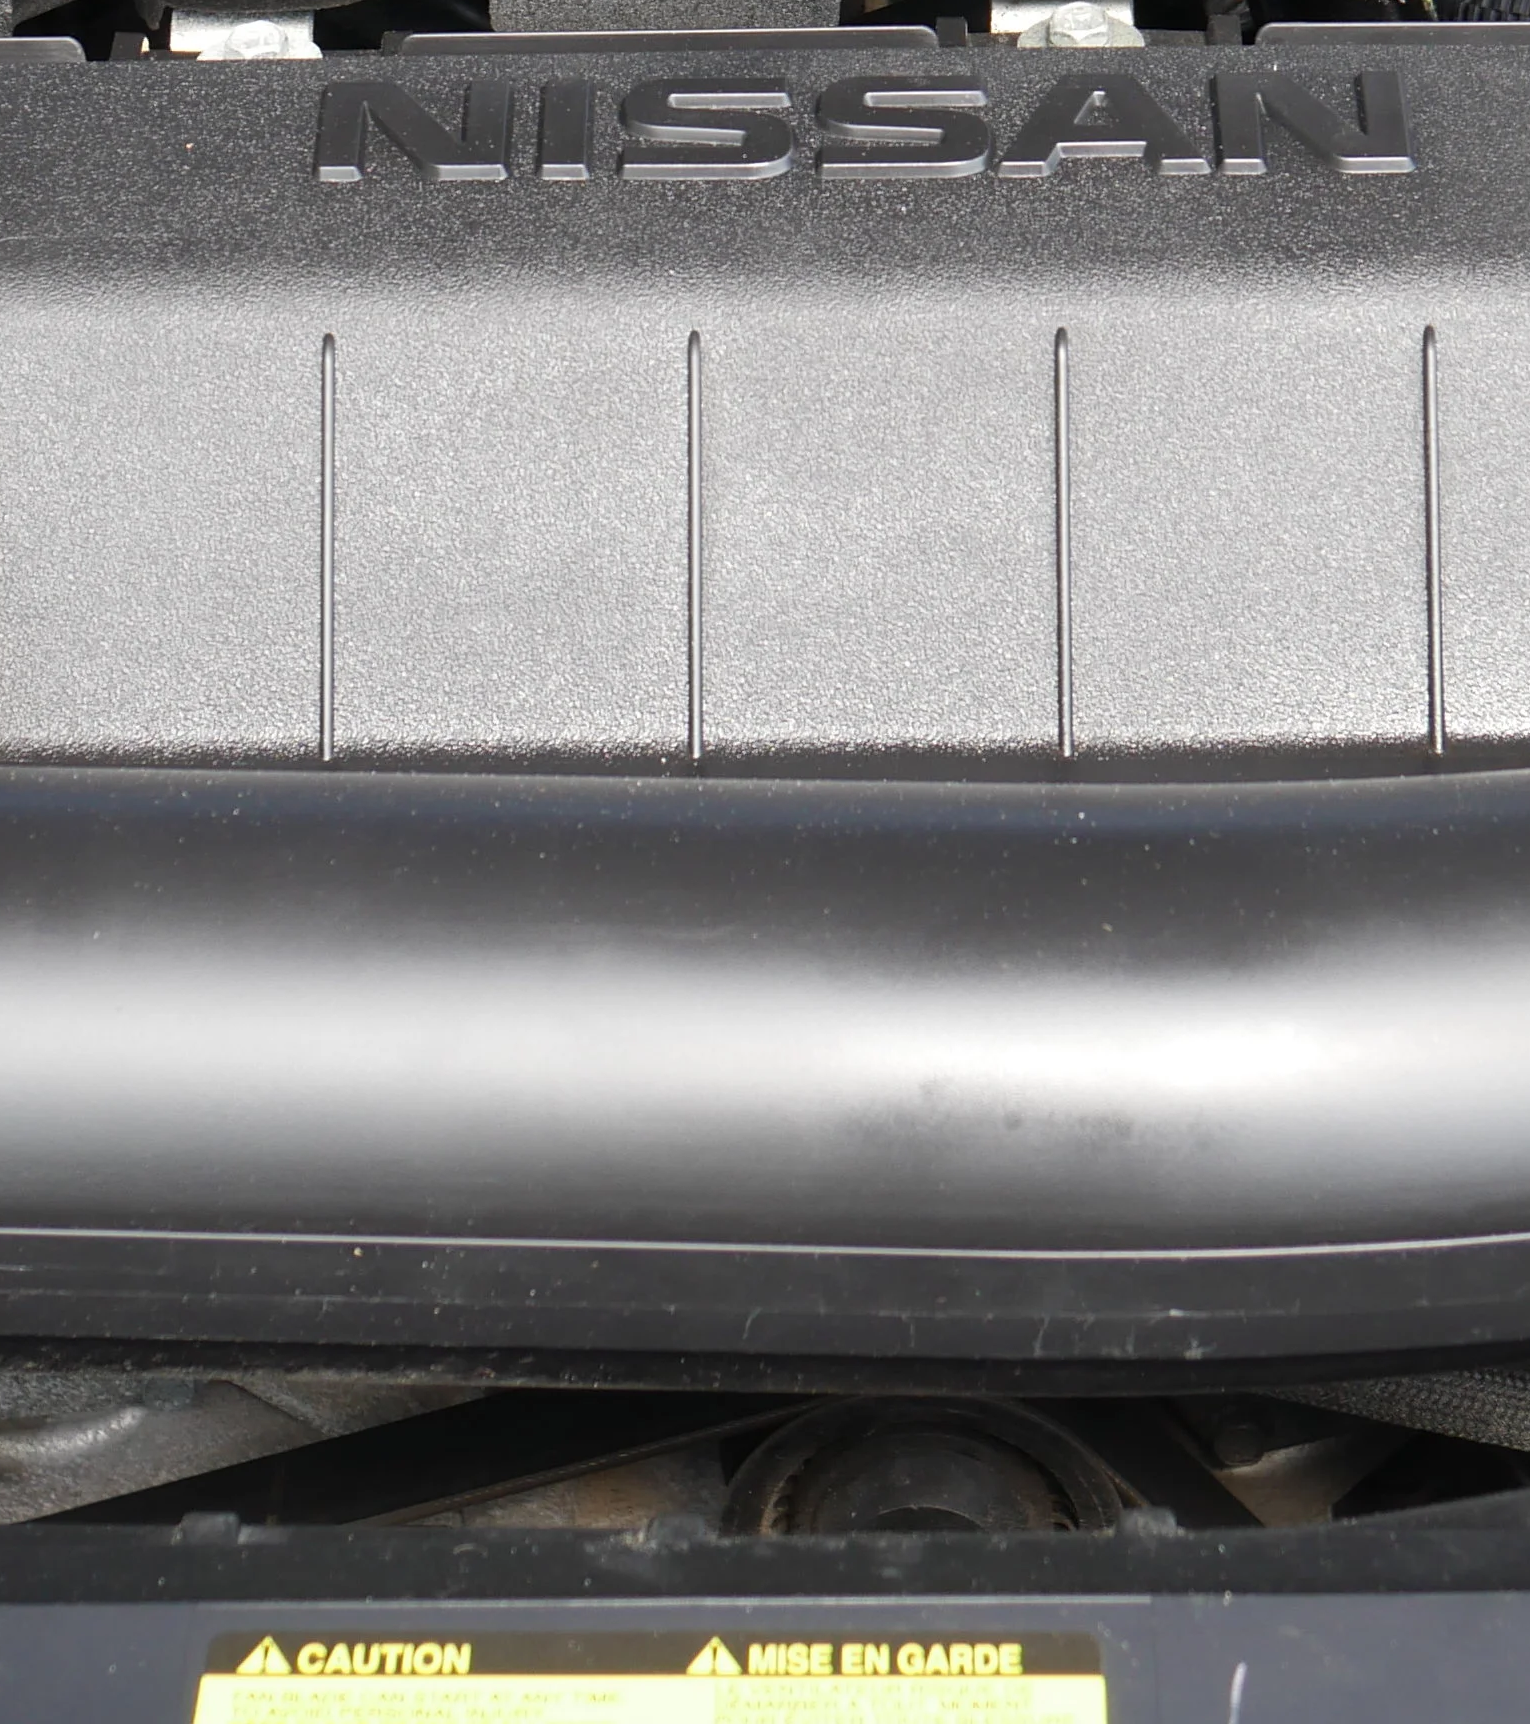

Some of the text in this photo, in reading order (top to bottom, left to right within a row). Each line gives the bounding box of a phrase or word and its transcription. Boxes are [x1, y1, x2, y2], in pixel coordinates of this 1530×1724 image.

[313, 70, 1418, 183] NISSAN
[296, 1642, 472, 1675] CAUTION
[748, 1642, 1024, 1675] MISE EN GARDE
